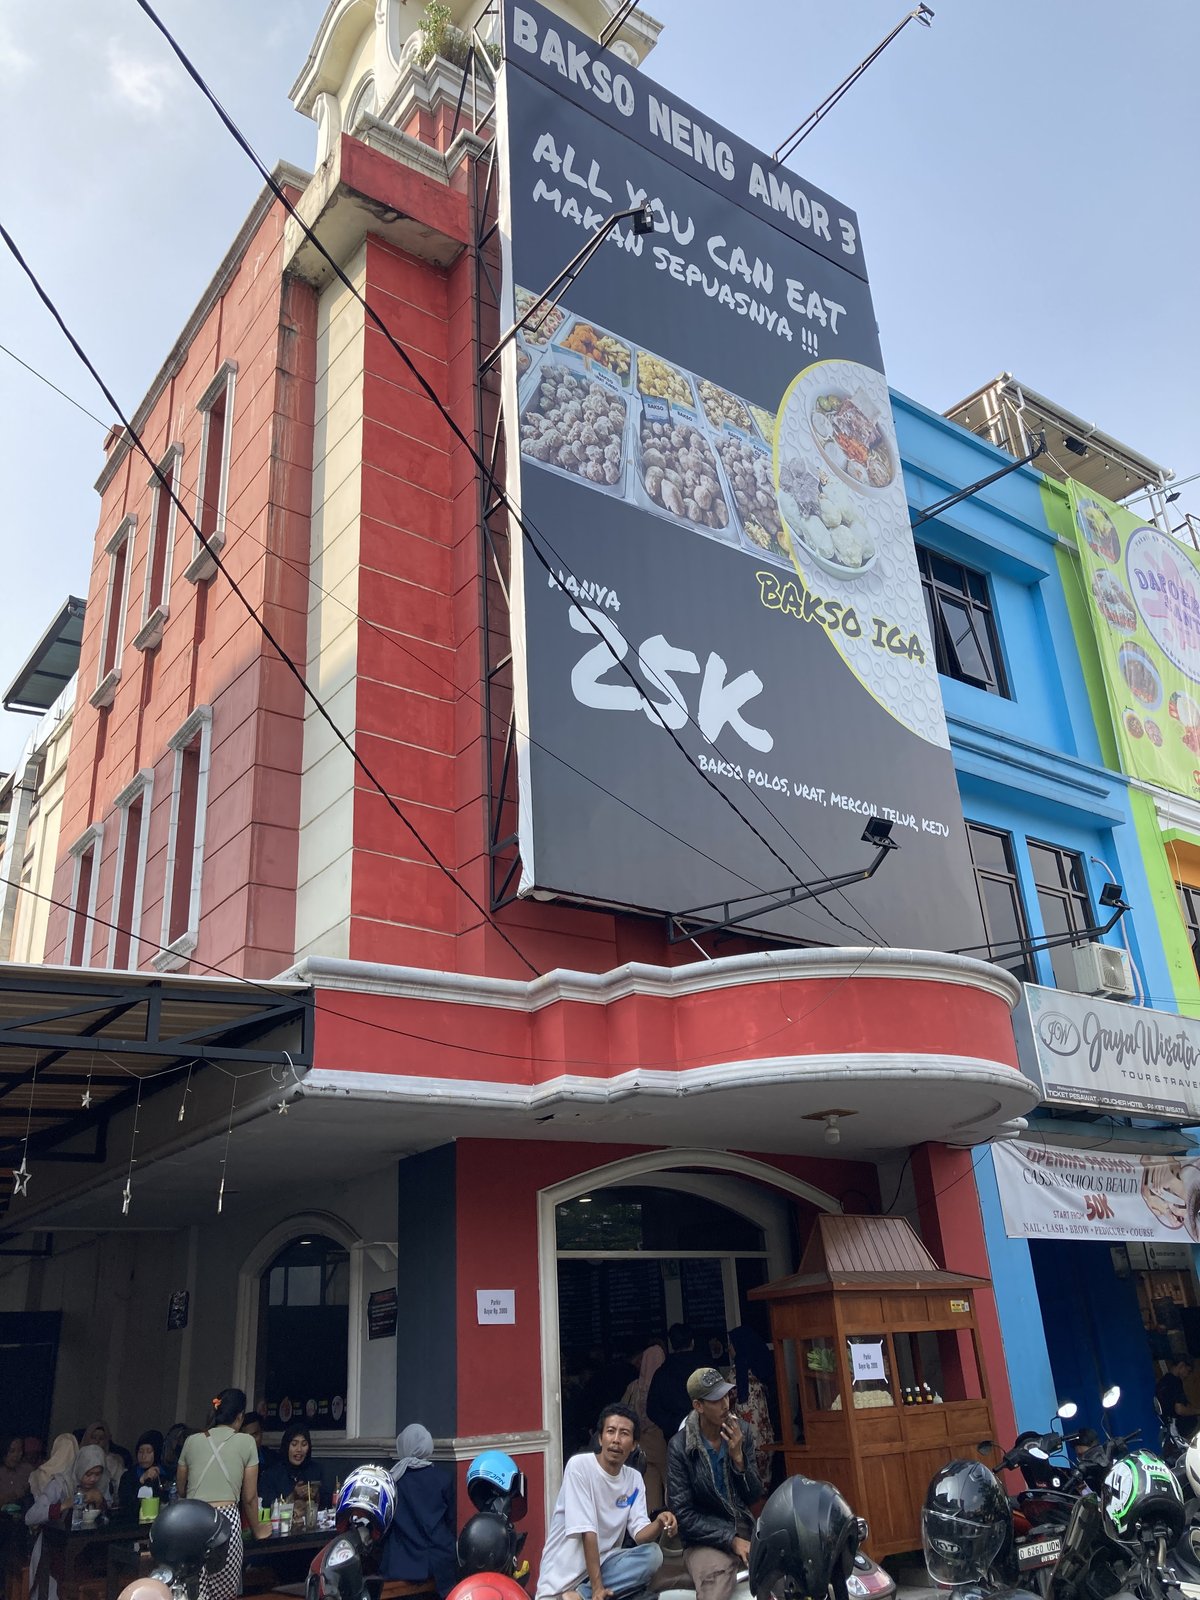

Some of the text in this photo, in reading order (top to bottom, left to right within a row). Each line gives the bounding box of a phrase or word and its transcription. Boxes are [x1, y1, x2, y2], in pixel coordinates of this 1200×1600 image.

[514, 7, 856, 255] BAKSO NENG AMOR 3
[532, 132, 613, 203] ALL
[707, 236, 774, 294] CAN
[786, 279, 847, 335] EAT
[533, 179, 644, 257] MAKAN
[653, 247, 793, 341] SEPUASNYA
[548, 568, 621, 611] HANYA
[756, 572, 925, 665] BAKSO IGA
[569, 605, 774, 753] 25K
[698, 755, 743, 780] BAKSO
[748, 769, 790, 797] POLOS,
[794, 783, 827, 807] URAT,
[882, 807, 919, 832] TELUR,
[922, 818, 949, 838] KEJU
[1083, 1012, 1200, 1072] Jaya Wisata
[1047, 1089, 1068, 1098] TICKET
[1121, 1070, 1152, 1082] TOUR
[1083, 1193, 1115, 1222] 50K
[1105, 1178, 1139, 1194] BEAUTY
[1023, 1223, 1042, 1233] NAIL
[1045, 1223, 1065, 1234] LASH
[1069, 1225, 1090, 1235] BROW
[1129, 1228, 1155, 1238] COURSE
[1053, 1210, 1070, 1220] START
